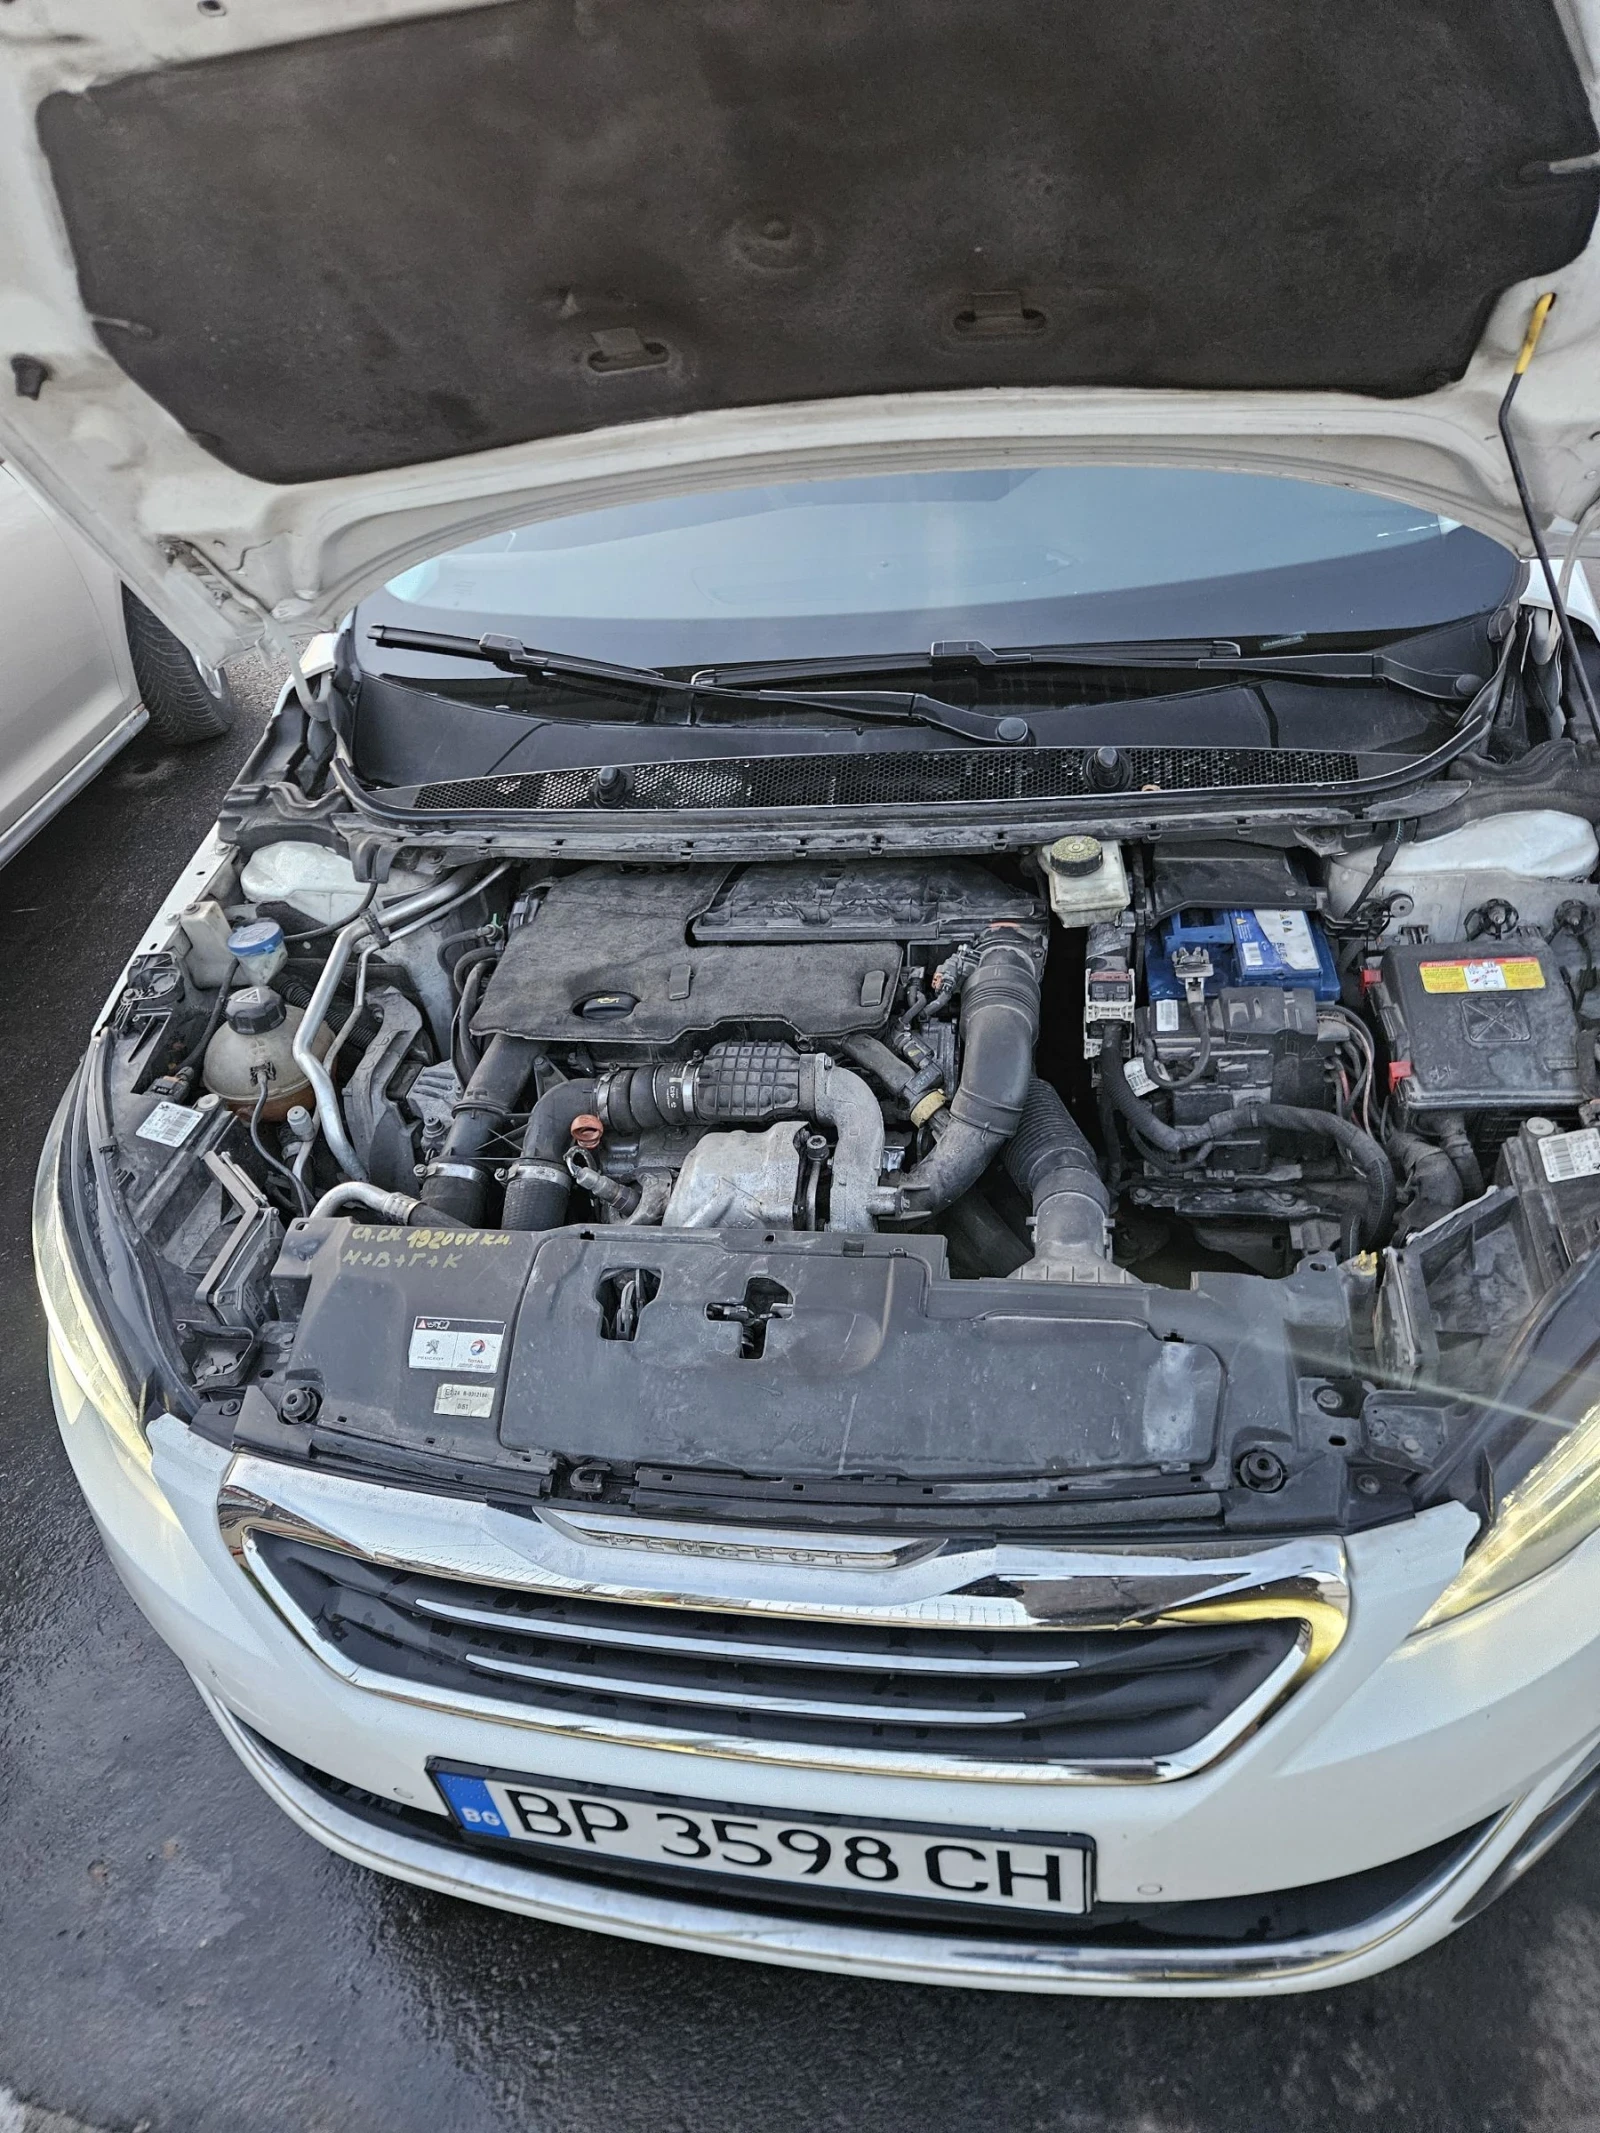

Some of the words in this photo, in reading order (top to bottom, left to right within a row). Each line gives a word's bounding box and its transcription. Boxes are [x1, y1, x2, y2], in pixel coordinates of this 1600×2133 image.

[407, 1229, 480, 1250] 192000
[611, 1535, 850, 1566] PEUGEOT
[461, 1806, 501, 1827] BG
[507, 1789, 630, 1845] BP
[656, 1812, 900, 1883] 3598
[924, 1844, 1062, 1903] CH
